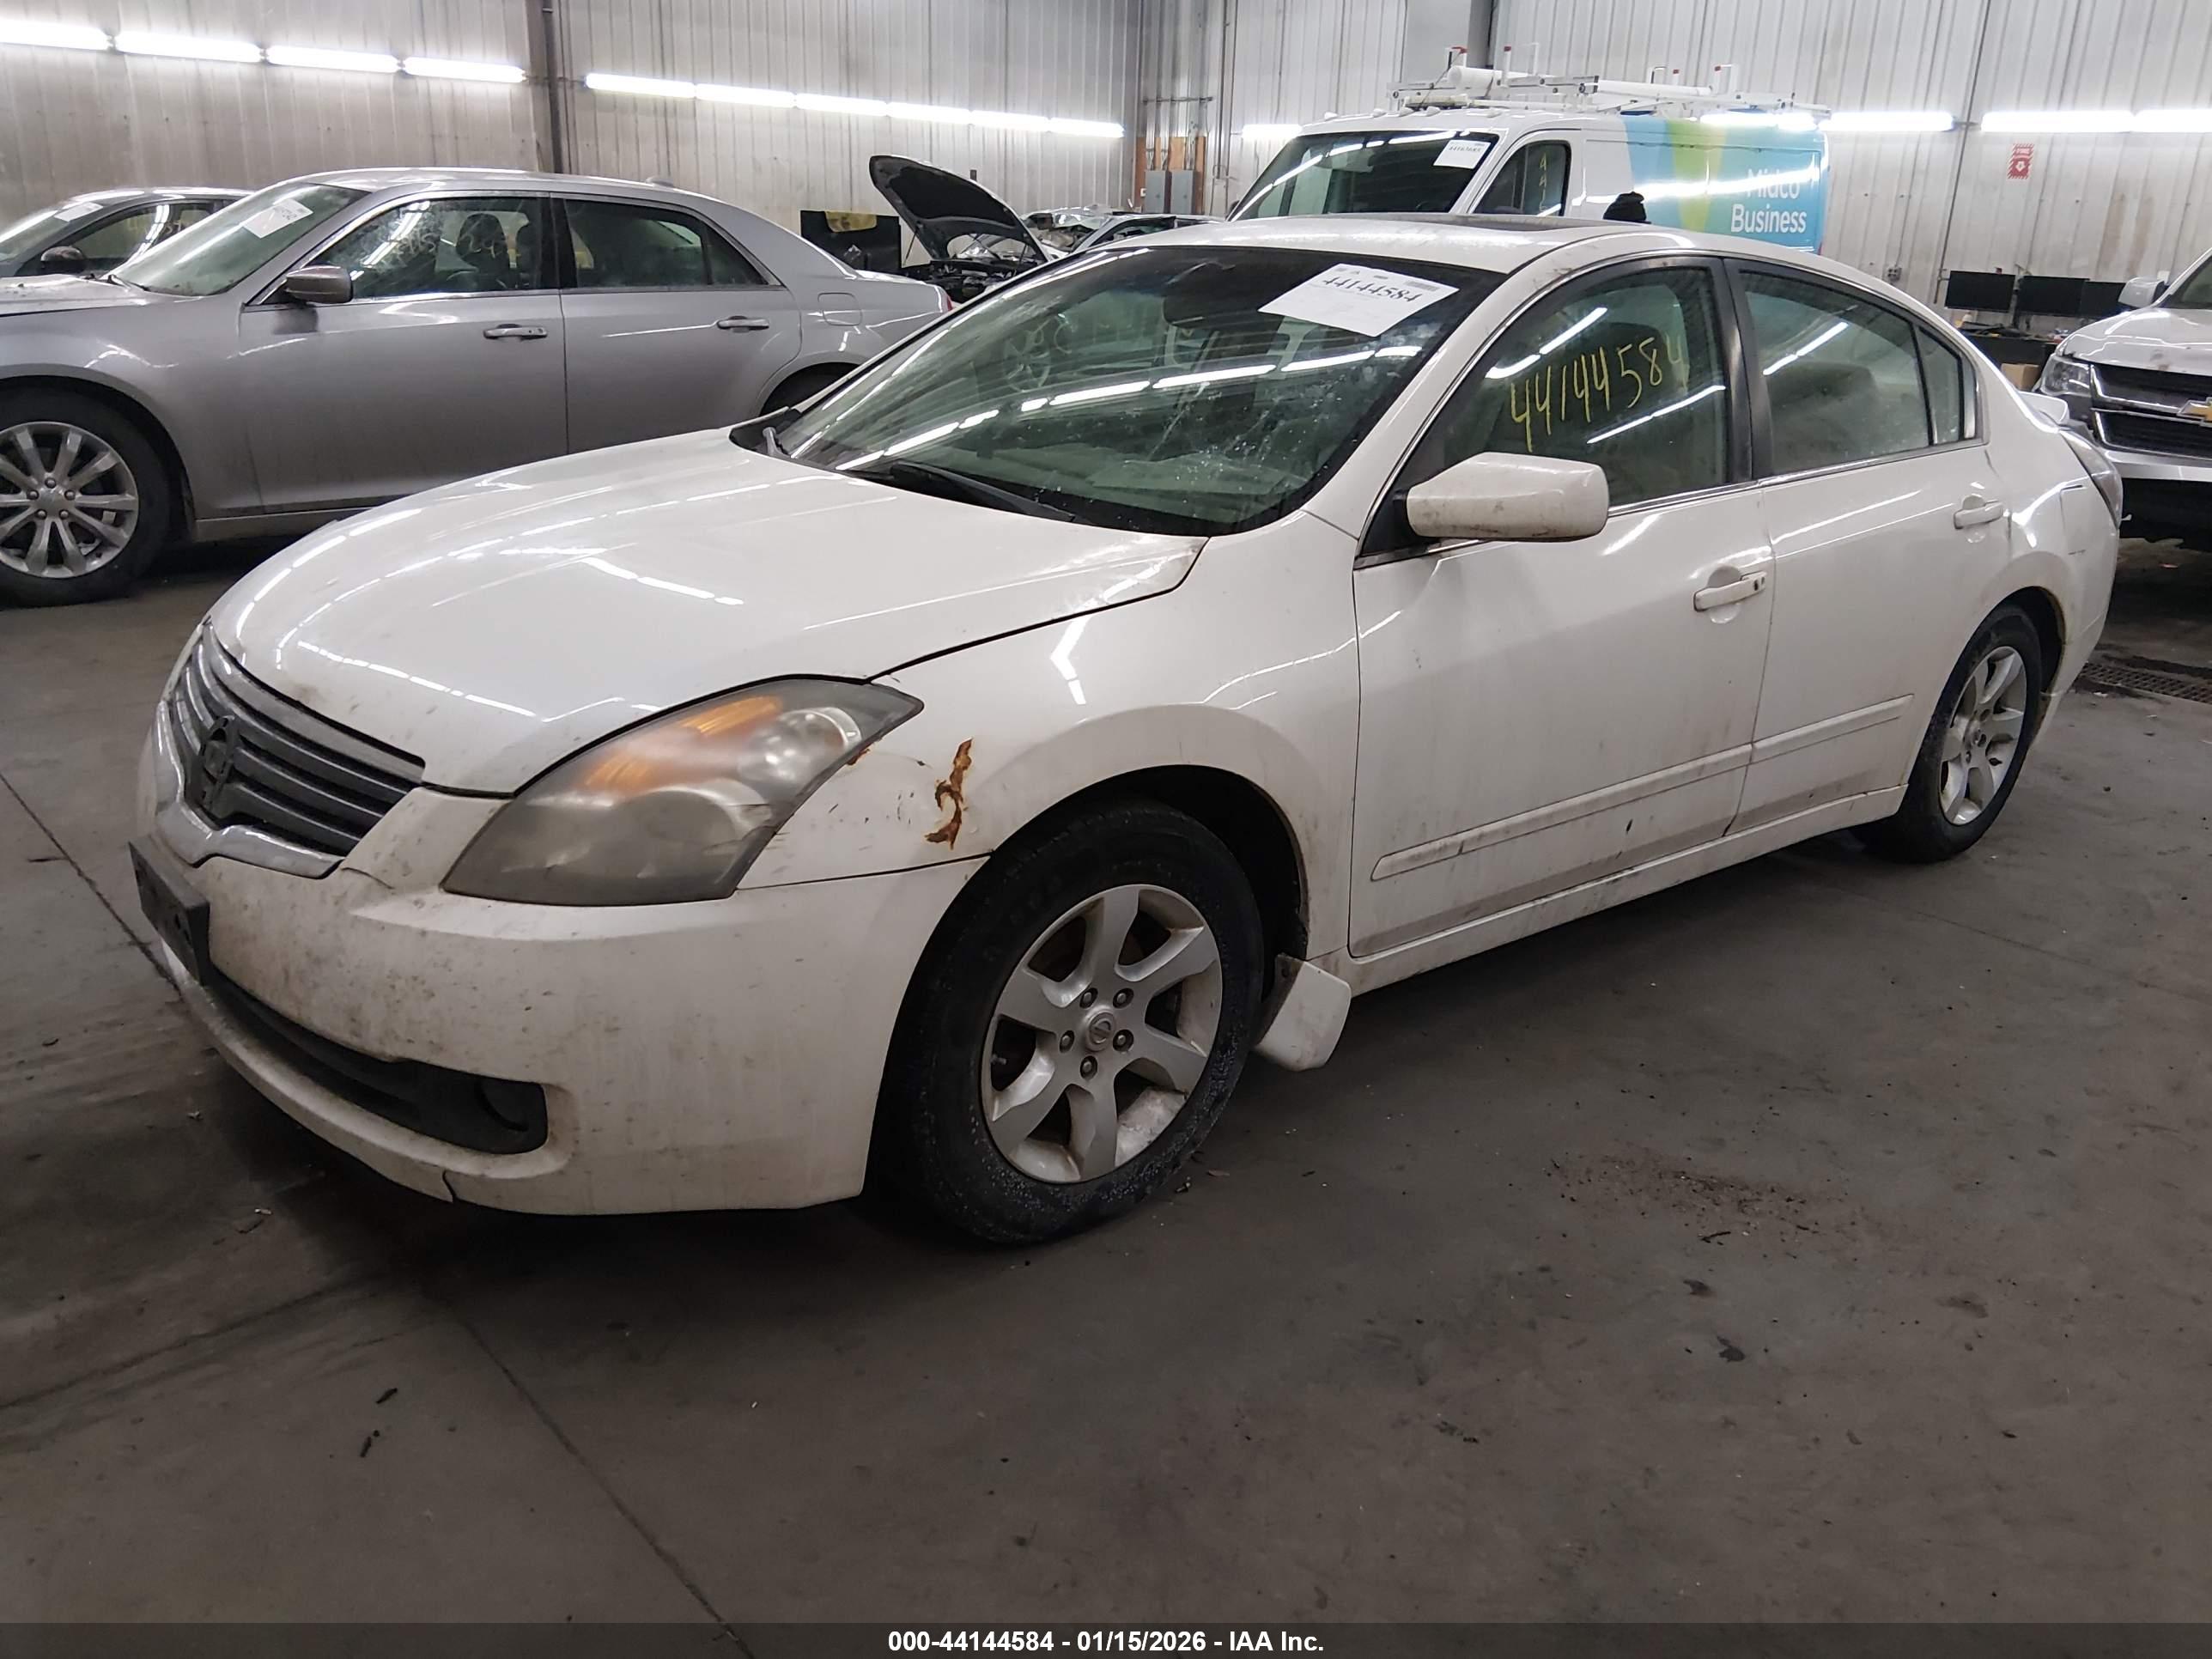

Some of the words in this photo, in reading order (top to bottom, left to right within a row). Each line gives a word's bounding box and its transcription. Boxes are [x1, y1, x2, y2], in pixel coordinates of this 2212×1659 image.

[1747, 168, 1801, 199] Midco
[1730, 204, 1808, 233] Business
[1322, 276, 1424, 301] 44144584
[1511, 335, 1688, 453] 44144584
